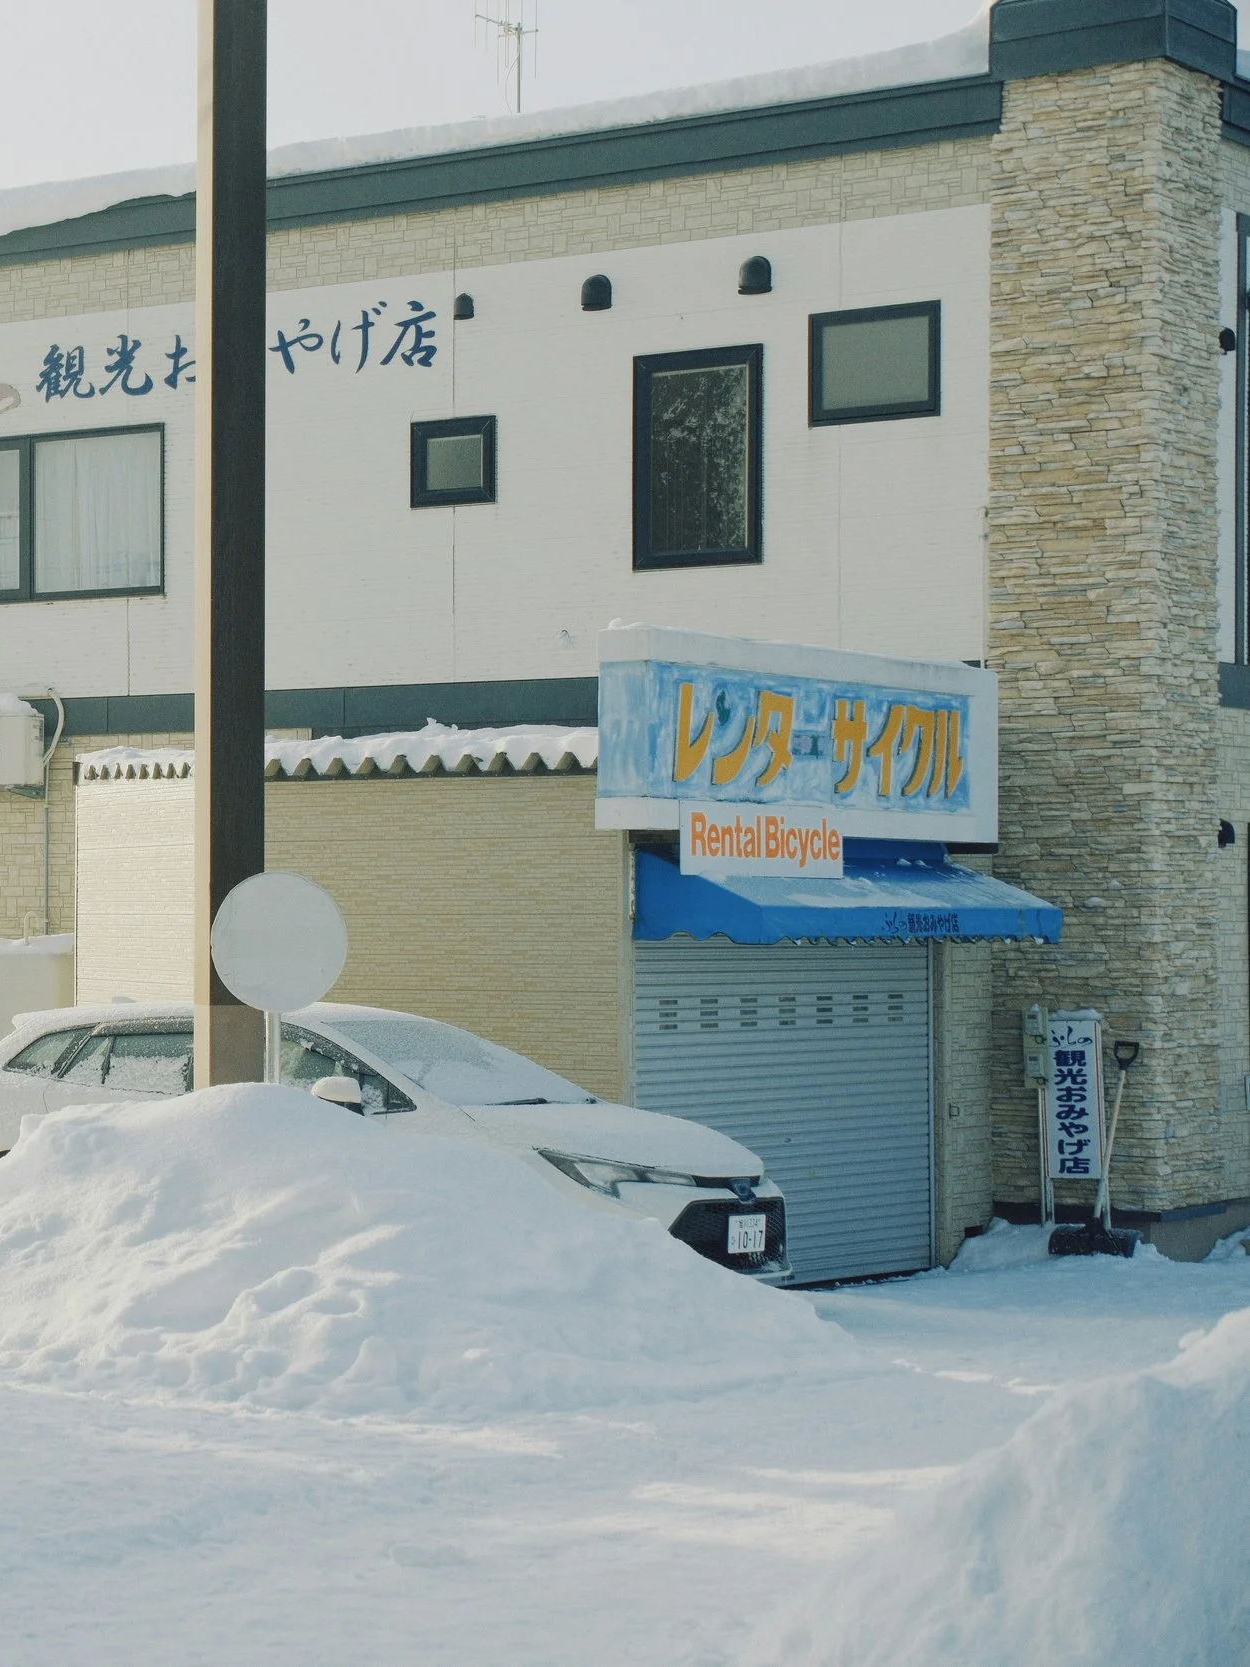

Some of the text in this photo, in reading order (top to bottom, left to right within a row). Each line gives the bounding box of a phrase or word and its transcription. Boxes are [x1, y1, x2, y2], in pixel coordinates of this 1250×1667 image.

[36, 300, 438, 403] 観光おやげ店
[690, 811, 841, 868] Rental Bicycle
[1054, 1050, 1091, 1174] 観光おみやげ店
